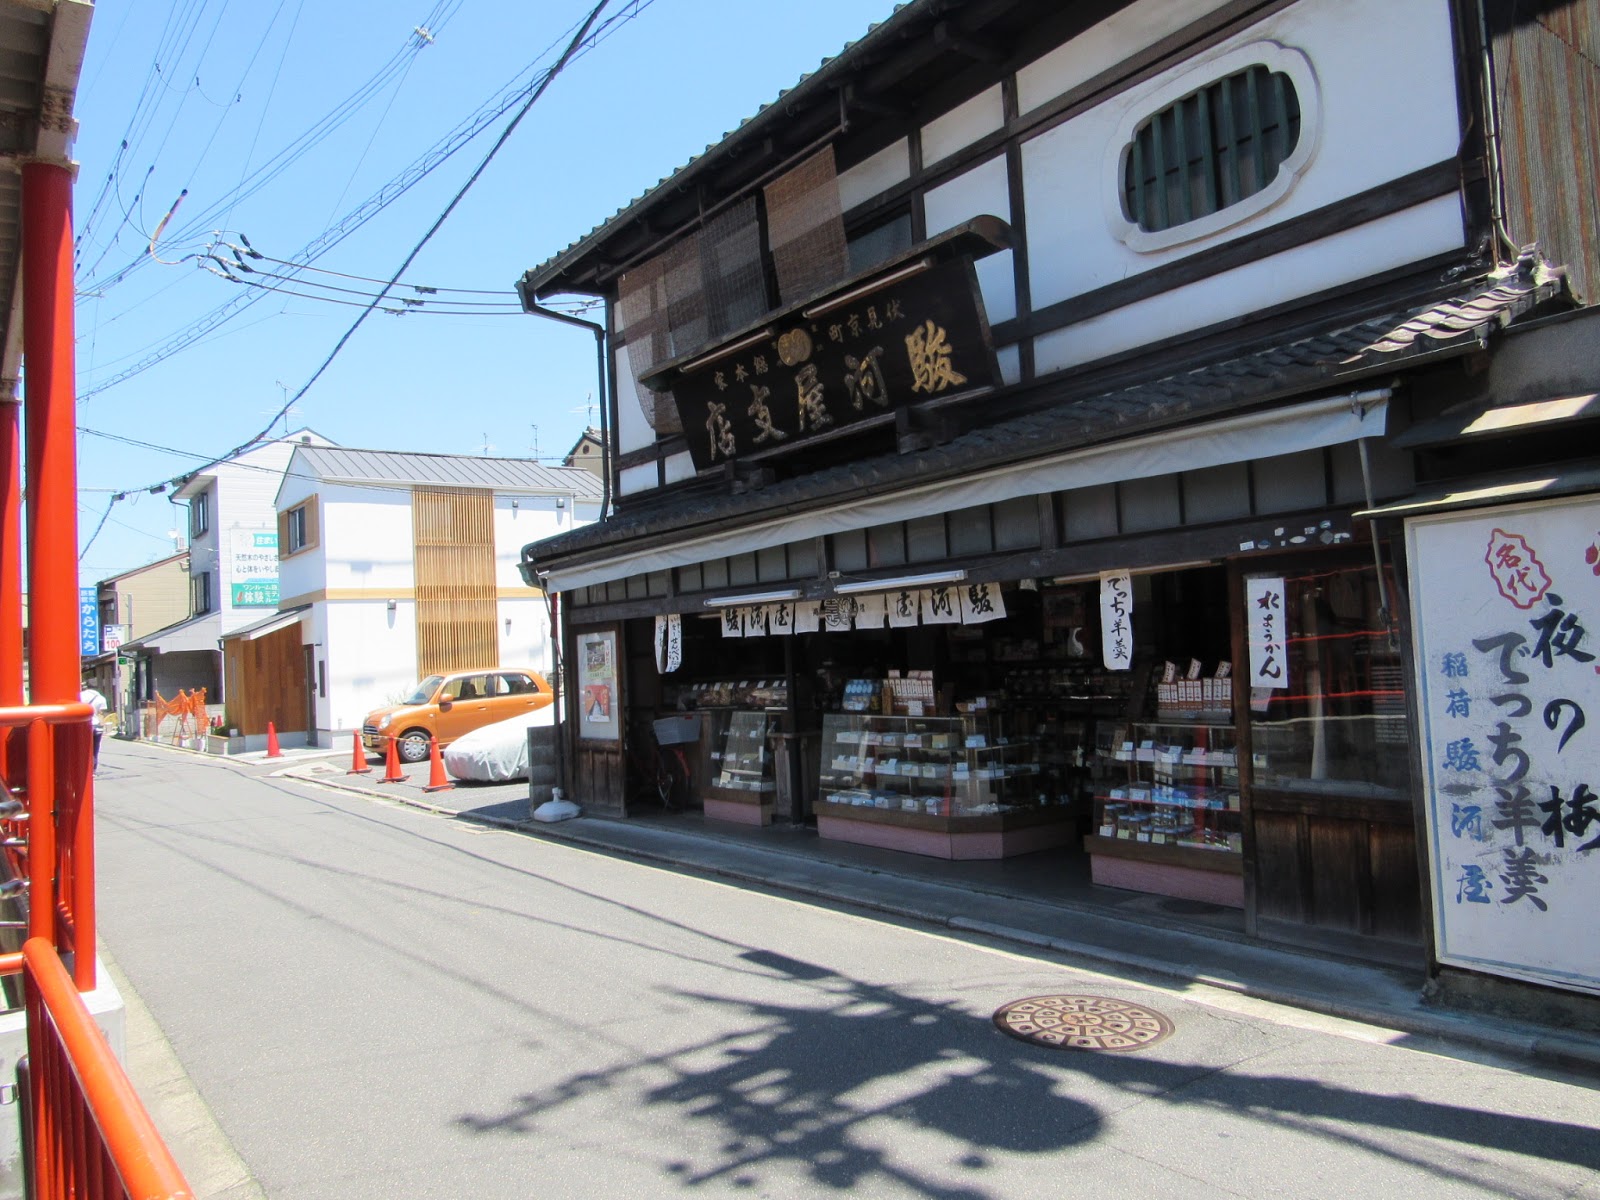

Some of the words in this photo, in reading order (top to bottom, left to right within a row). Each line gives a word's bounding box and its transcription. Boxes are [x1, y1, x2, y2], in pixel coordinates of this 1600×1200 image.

[1495, 543, 1537, 596] 名代
[81, 604, 96, 652] からたち
[1528, 592, 1600, 854] 夜の梅
